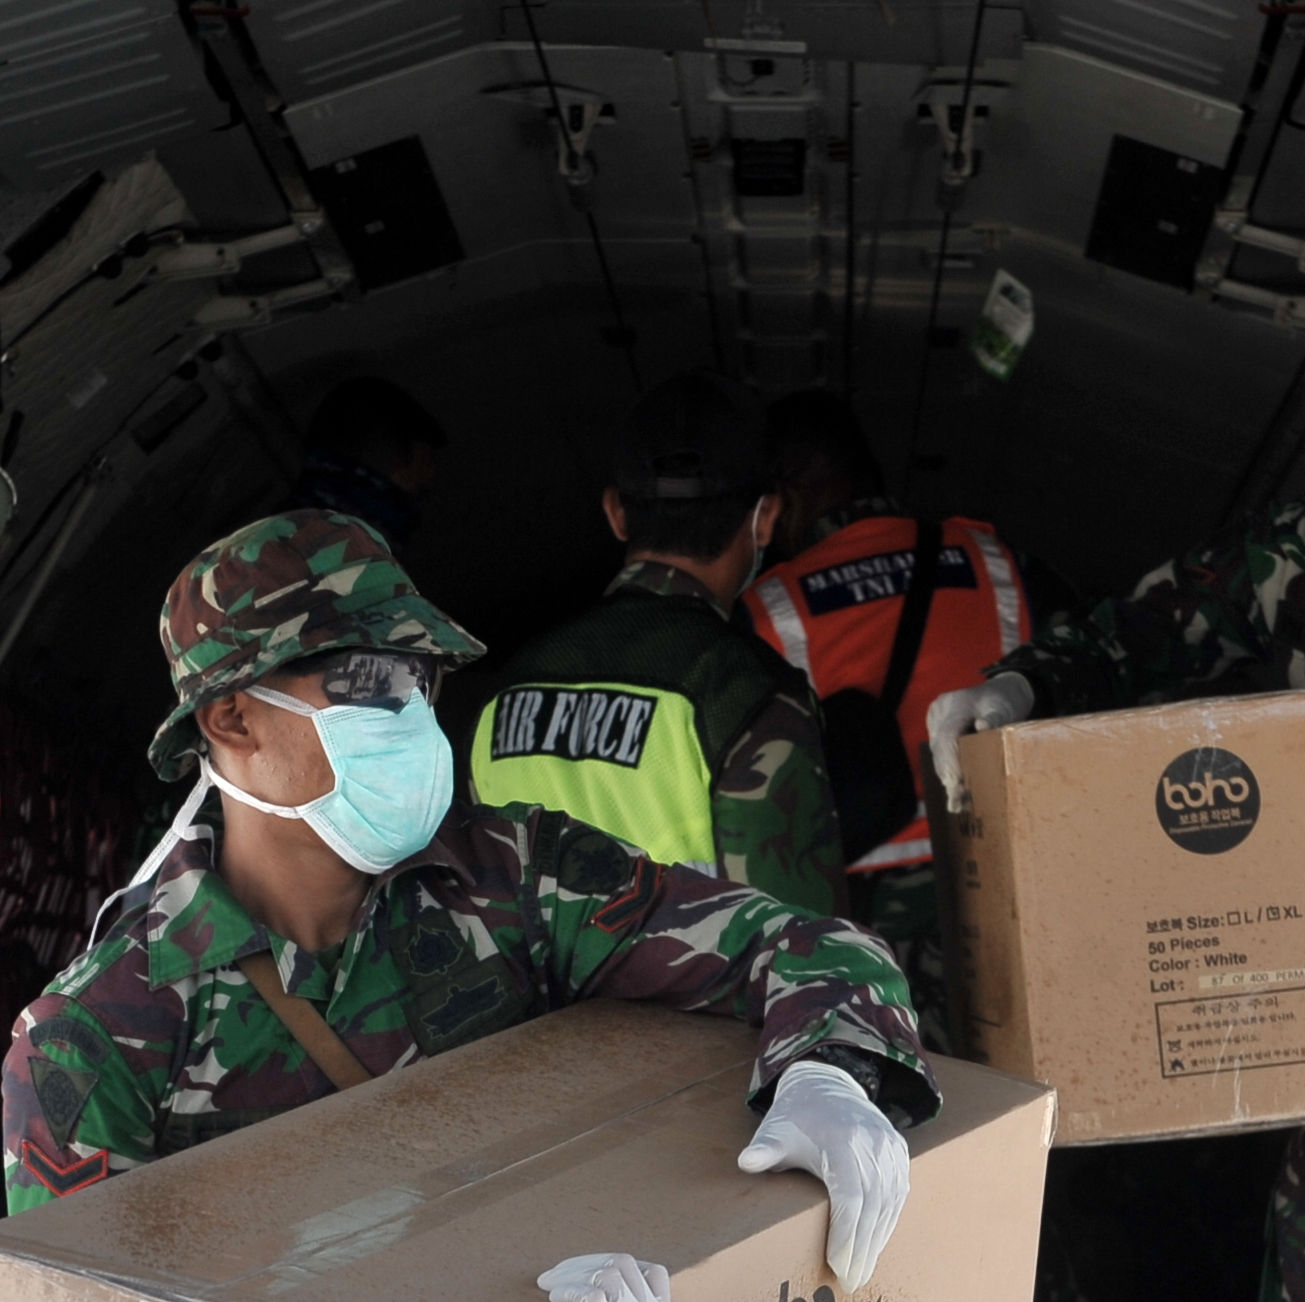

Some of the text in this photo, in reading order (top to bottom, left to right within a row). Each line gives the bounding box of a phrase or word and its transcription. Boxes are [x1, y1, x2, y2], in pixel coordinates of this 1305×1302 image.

[807, 549, 964, 591] MARSHAR
[850, 574, 895, 602] TNI
[493, 691, 652, 763] AIR FORCE
[1163, 772, 1249, 810] boho
[1186, 914, 1224, 930] Size:
[1283, 906, 1303, 920] XL
[1148, 935, 1220, 955] 50 Pieces
[1149, 957, 1191, 972] Color
[1203, 953, 1248, 967] White
[1150, 979, 1176, 993] Lot
[1250, 973, 1269, 983] 400
